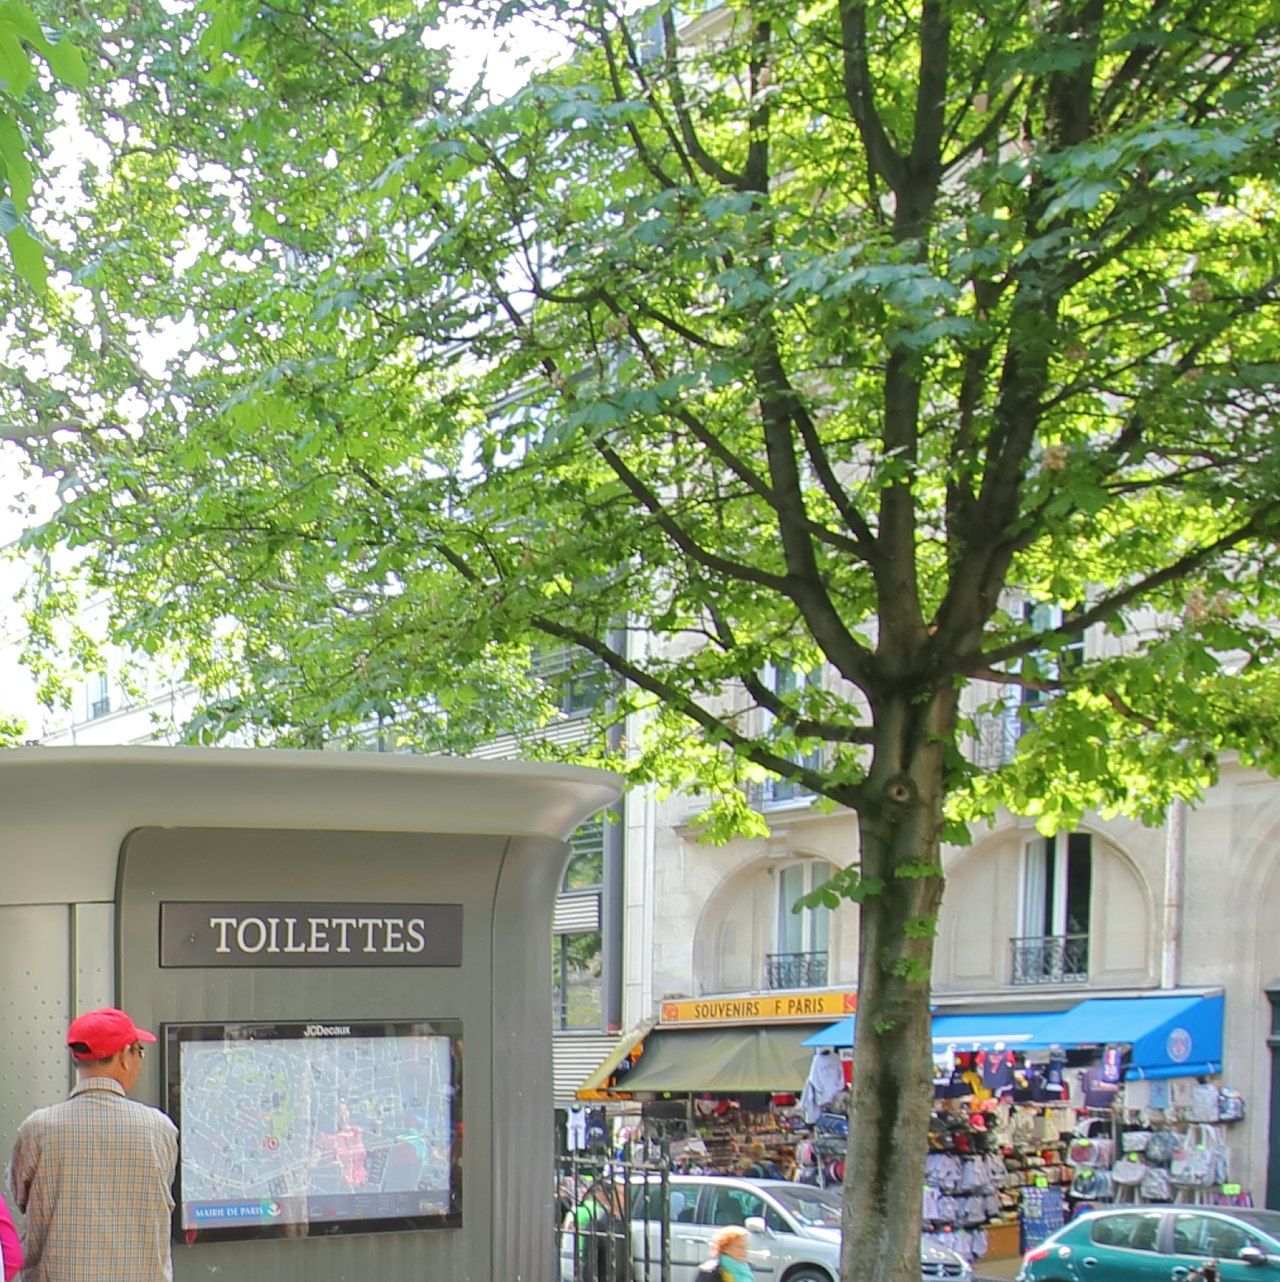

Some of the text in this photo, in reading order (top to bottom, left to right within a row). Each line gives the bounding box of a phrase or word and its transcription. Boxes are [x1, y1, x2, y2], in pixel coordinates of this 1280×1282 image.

[210, 917, 425, 953] TOILETTES
[694, 1001, 760, 1018] SOUVENIRS
[789, 997, 825, 1013] PARIS
[303, 1024, 351, 1037] JCDecaux
[195, 1206, 263, 1218] MAIRIE DE PARIS
